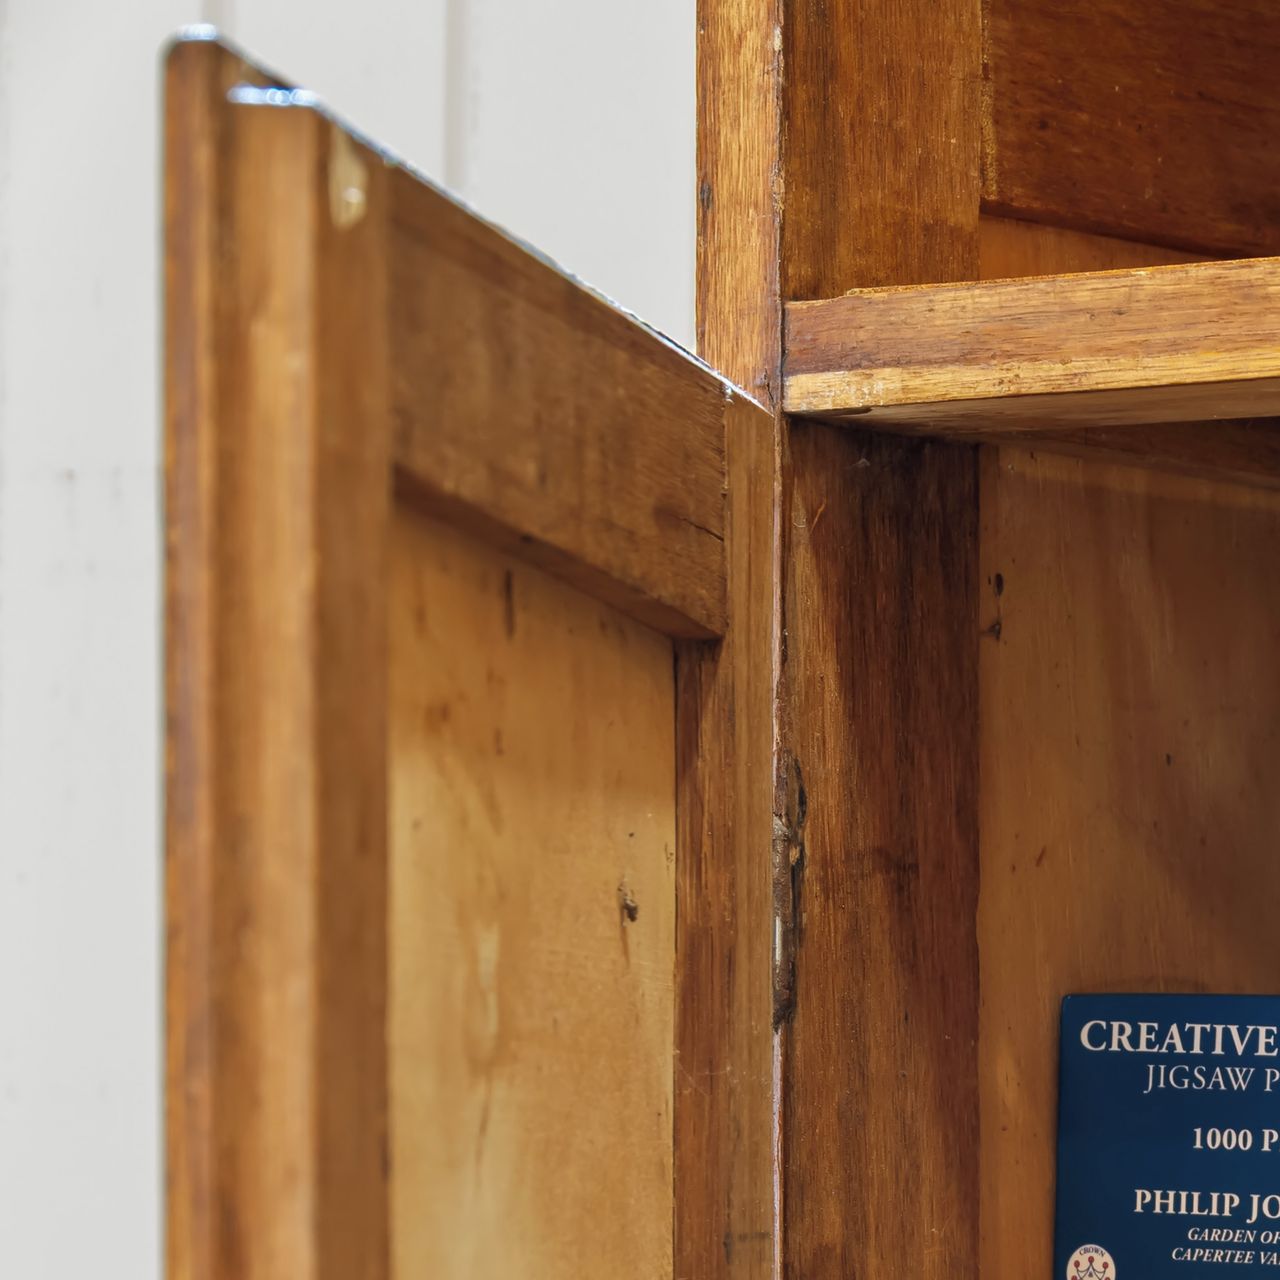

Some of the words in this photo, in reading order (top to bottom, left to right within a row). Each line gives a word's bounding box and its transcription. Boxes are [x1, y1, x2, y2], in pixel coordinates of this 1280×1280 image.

[1079, 1020, 1279, 1057] CREATIVE
[1143, 1064, 1255, 1095] JIGSAW
[1192, 1127, 1253, 1151] 1000
[1133, 1189, 1241, 1217] PHILIP
[1187, 1228, 1257, 1245] GARDEN
[1078, 1246, 1106, 1258] CROWN
[1171, 1247, 1256, 1265] CAPERTEE
